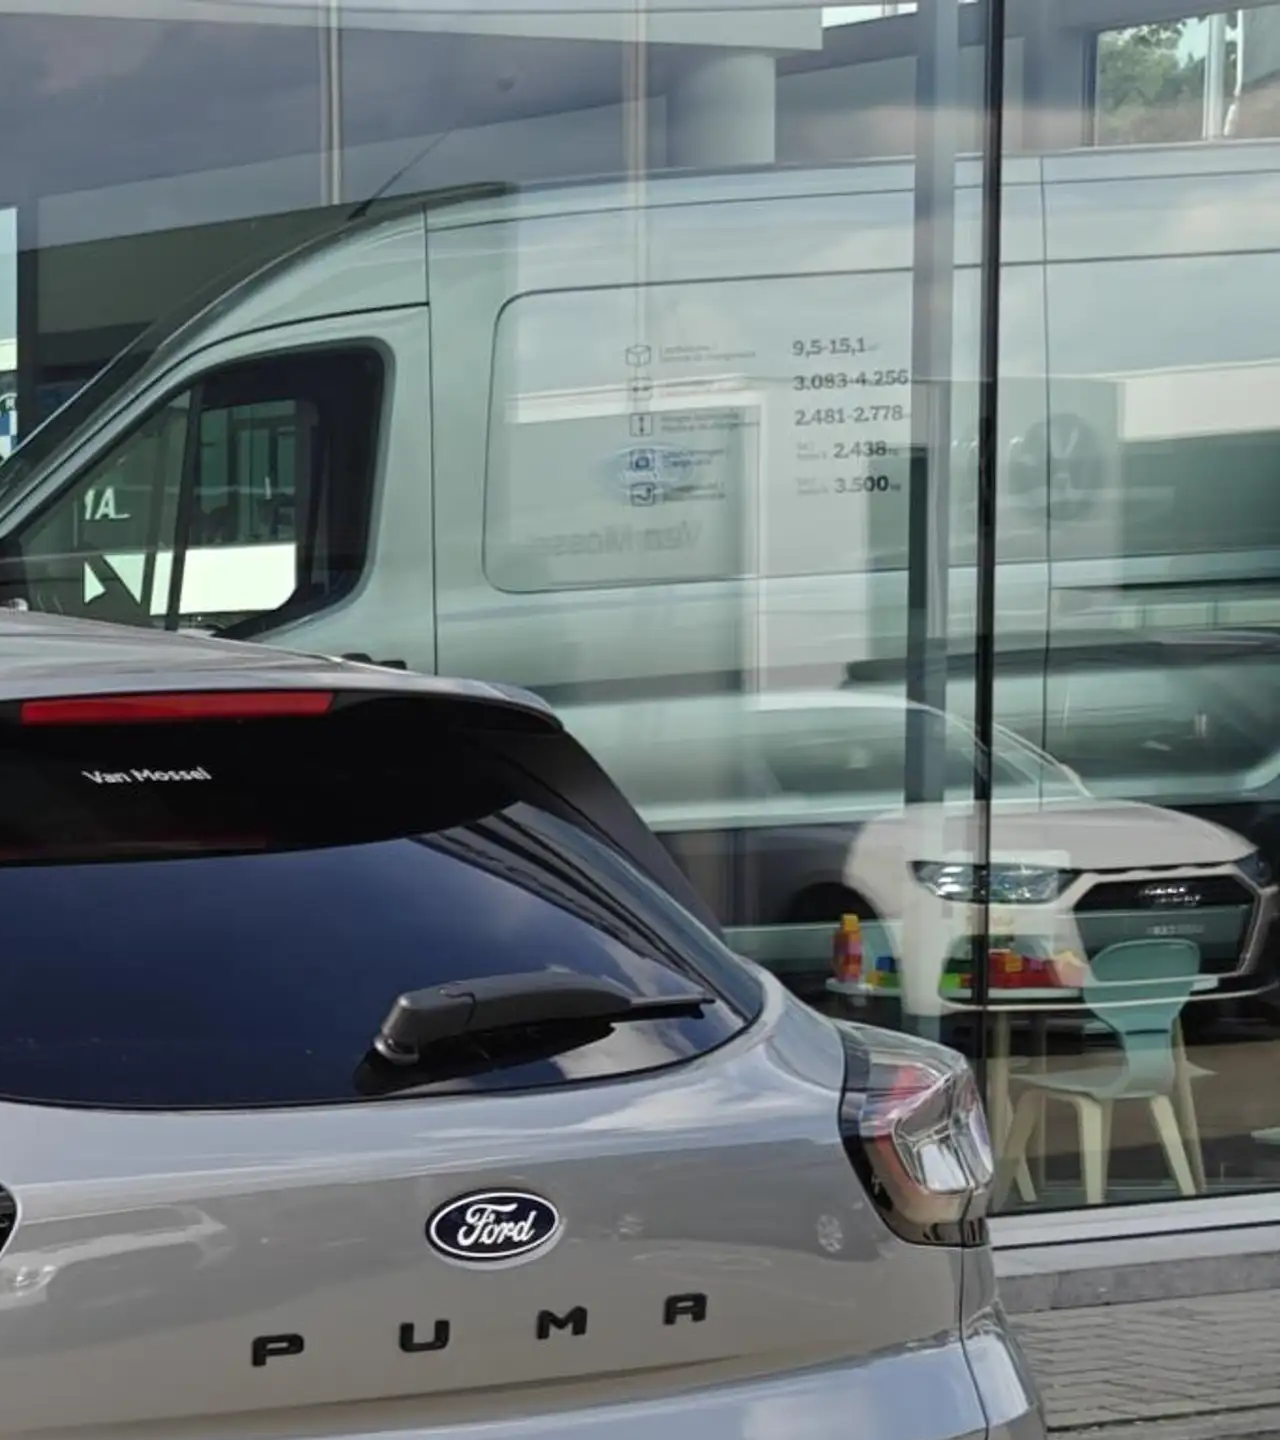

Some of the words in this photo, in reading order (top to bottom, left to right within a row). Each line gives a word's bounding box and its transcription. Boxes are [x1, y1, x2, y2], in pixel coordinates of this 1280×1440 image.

[834, 475, 889, 493] 3.500
[81, 770, 132, 784] Van
[130, 766, 212, 782] Mossel
[456, 1203, 536, 1247] Ford
[251, 1293, 709, 1367] PUMA
